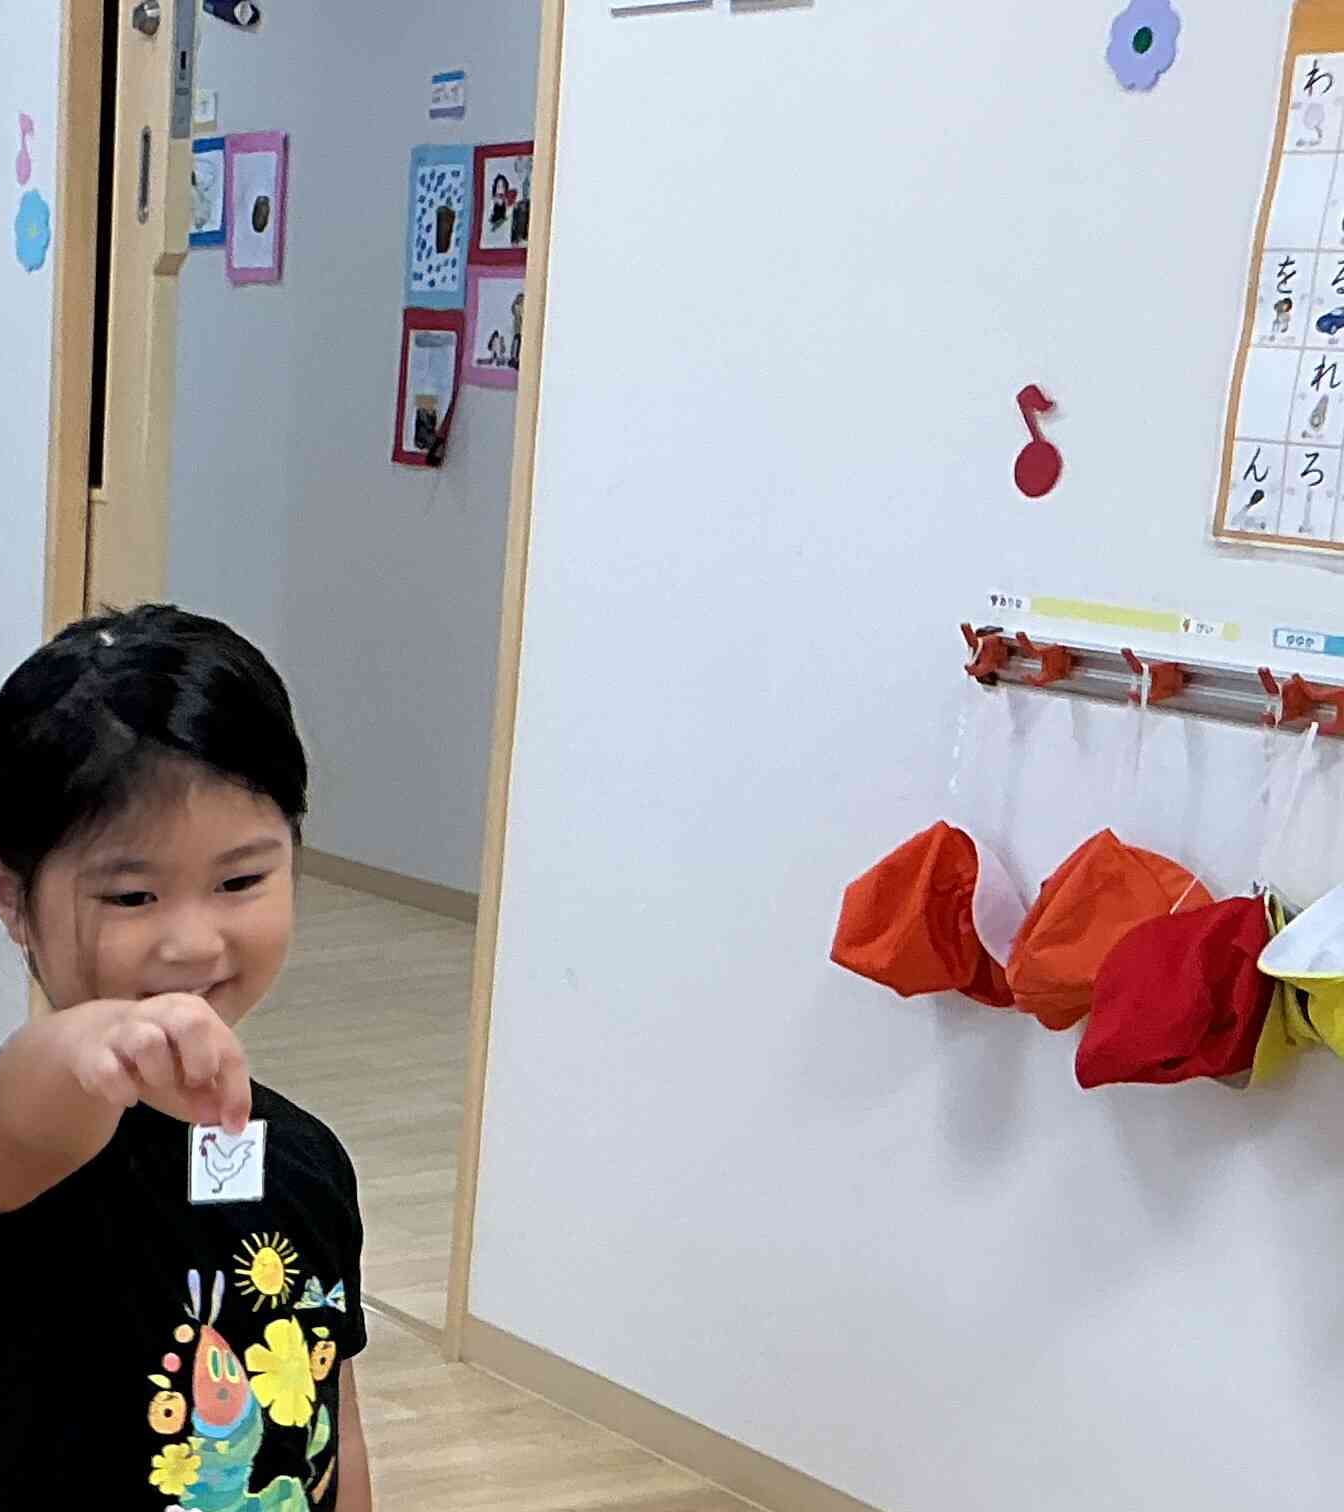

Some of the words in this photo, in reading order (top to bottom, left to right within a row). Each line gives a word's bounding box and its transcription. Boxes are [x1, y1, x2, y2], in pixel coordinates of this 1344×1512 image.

[1303, 58, 1334, 97] わ
[1275, 255, 1297, 294] を
[1310, 354, 1342, 392] れ
[1242, 447, 1270, 483] ん
[1300, 452, 1325, 487] ろ
